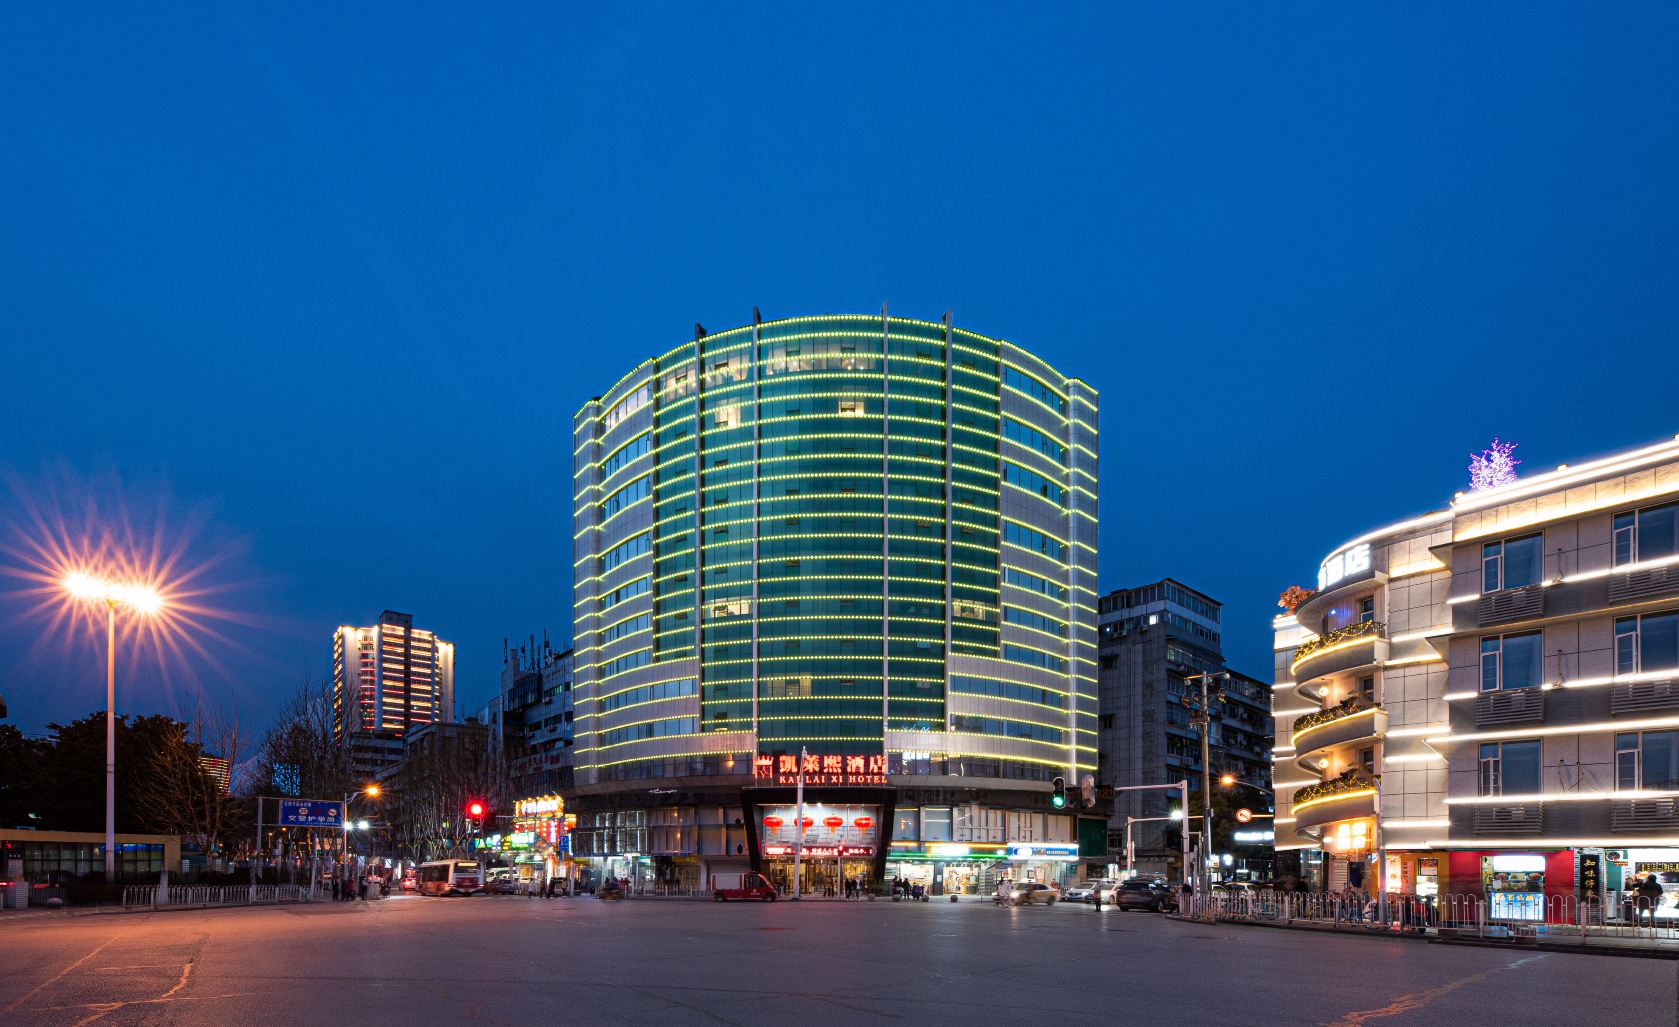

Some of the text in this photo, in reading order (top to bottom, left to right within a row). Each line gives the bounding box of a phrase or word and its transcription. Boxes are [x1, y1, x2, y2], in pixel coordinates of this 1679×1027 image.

[805, 775, 826, 784] LAI
[831, 775, 843, 784] XI
[849, 775, 888, 784] HOTEL
